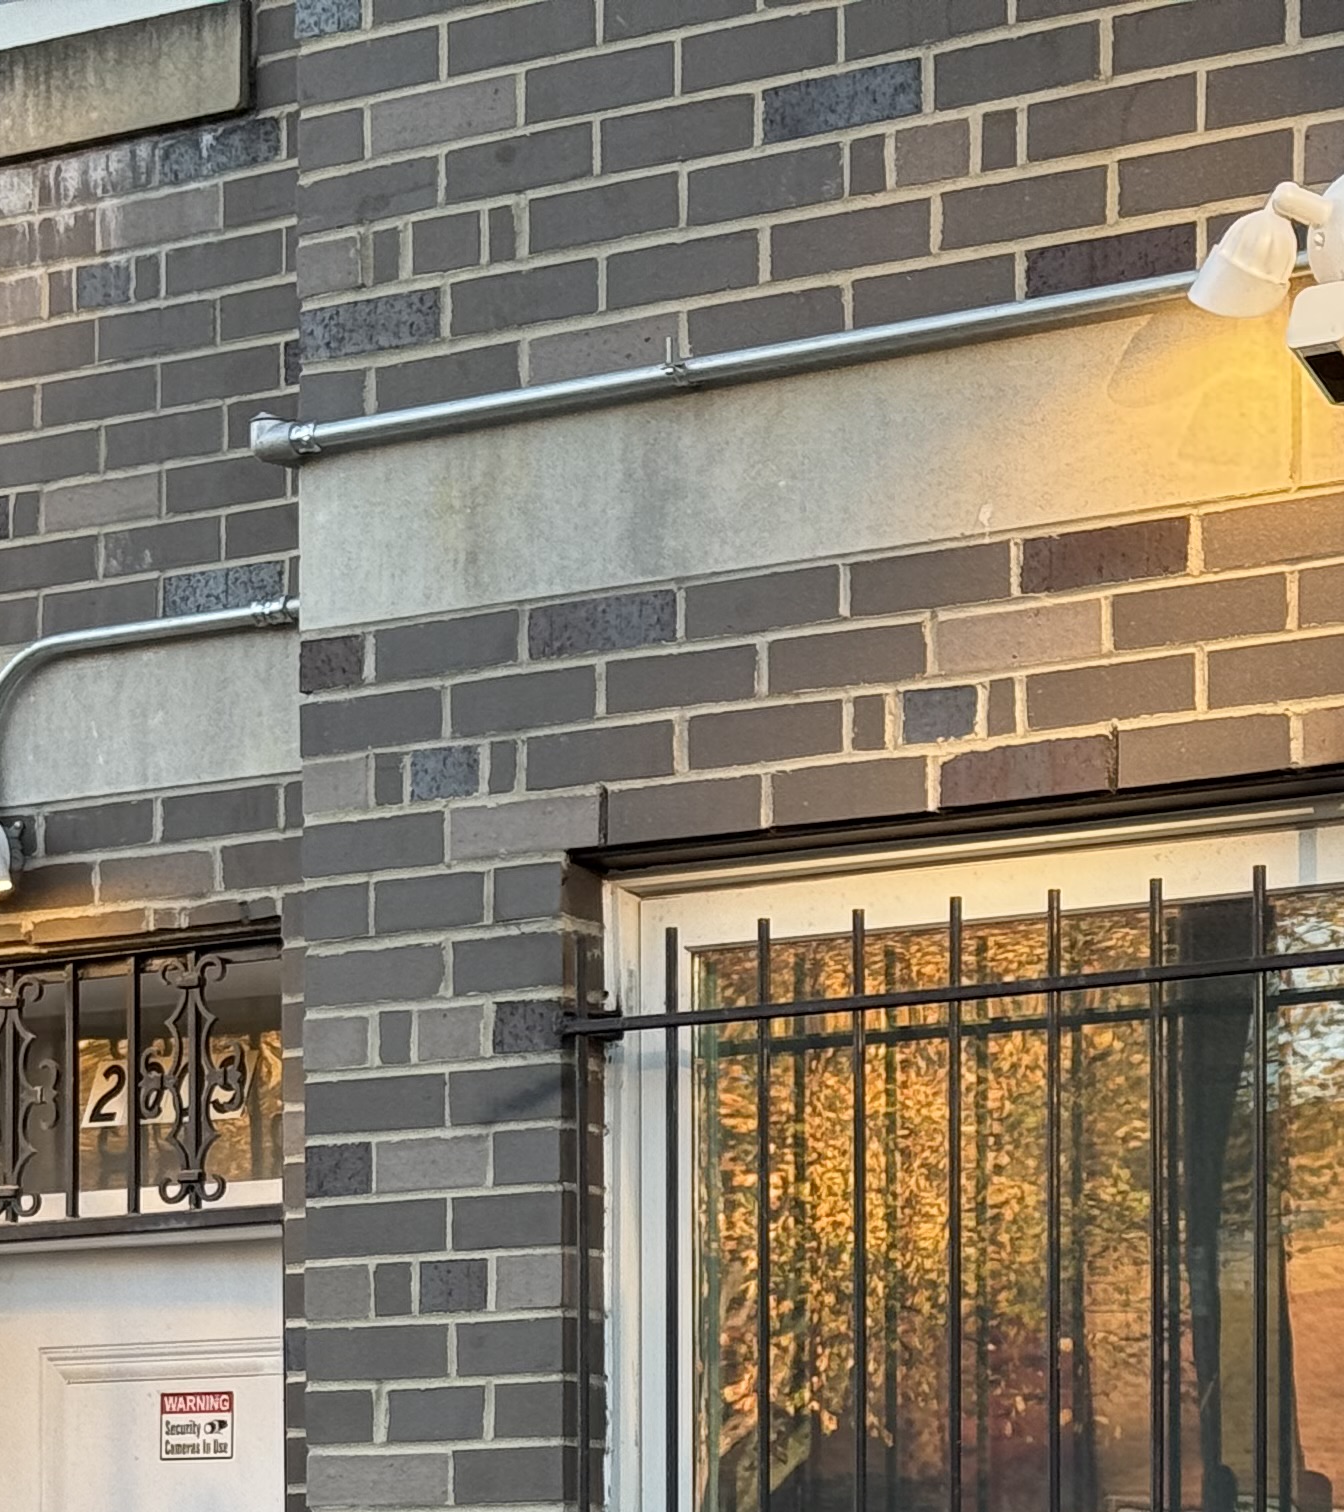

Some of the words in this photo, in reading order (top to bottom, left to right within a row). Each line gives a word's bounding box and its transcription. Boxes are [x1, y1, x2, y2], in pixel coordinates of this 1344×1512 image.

[164, 1394, 230, 1412] WARNING
[165, 1420, 201, 1439] Security
[165, 1439, 201, 1455] Cameras
[213, 1439, 229, 1454] Use
